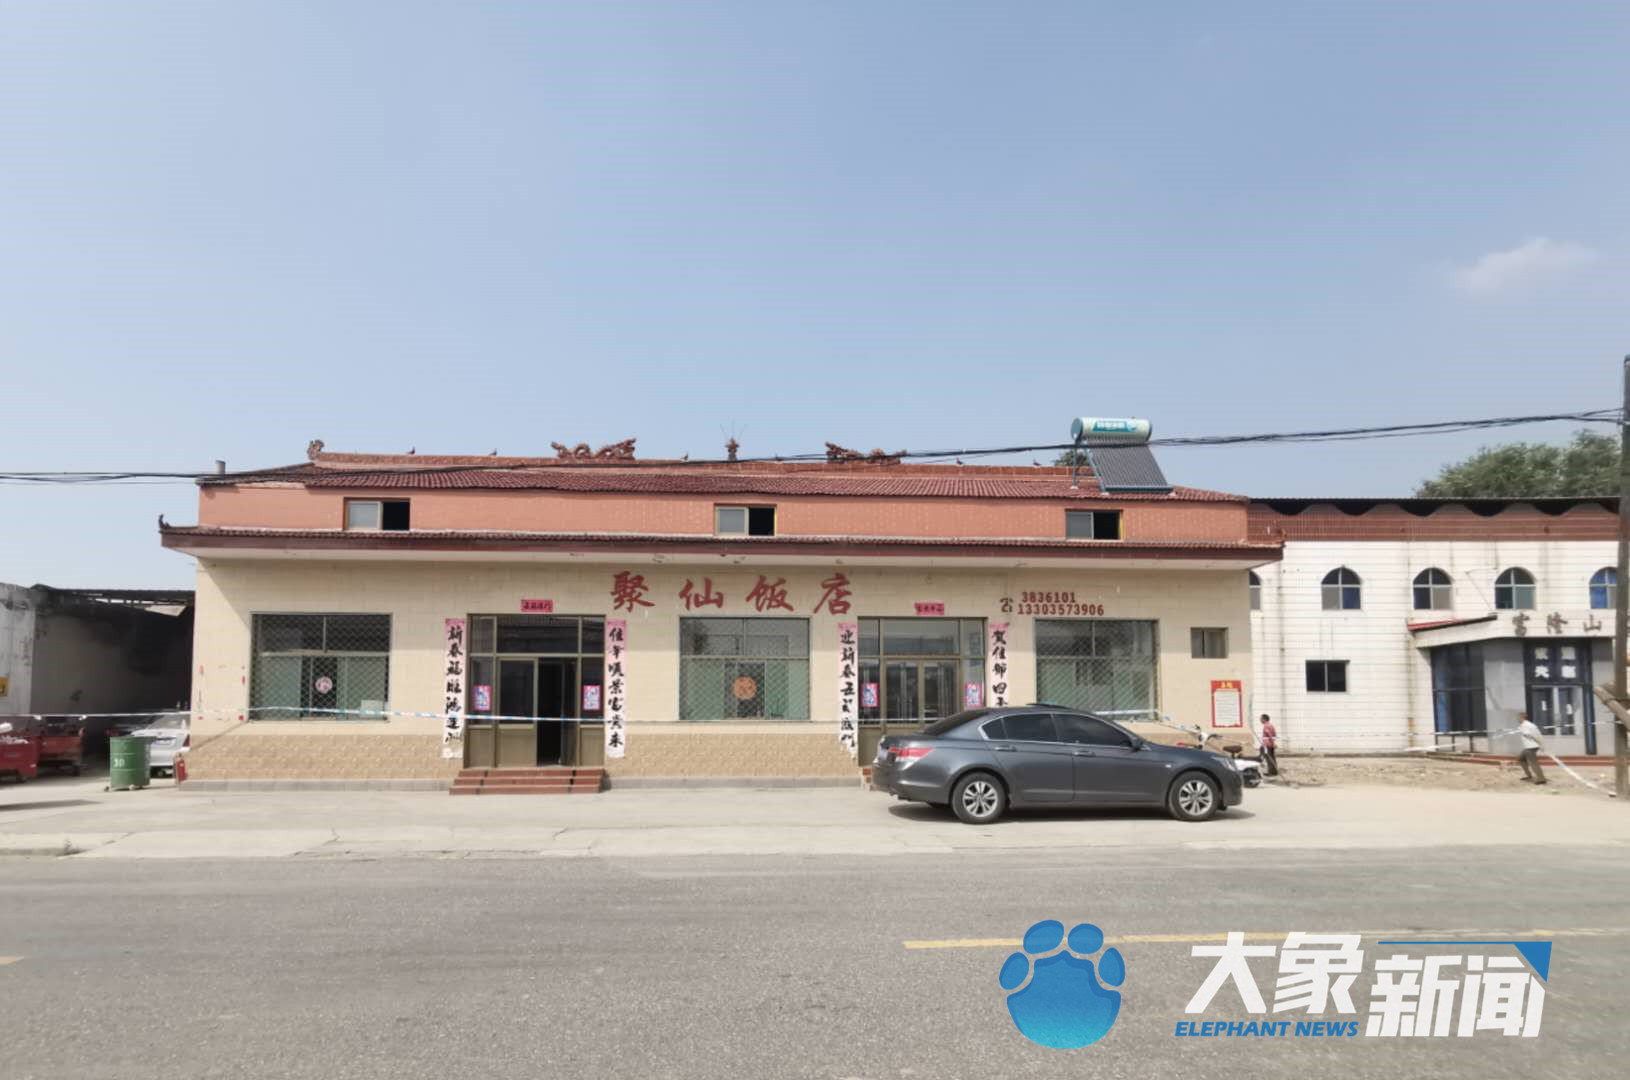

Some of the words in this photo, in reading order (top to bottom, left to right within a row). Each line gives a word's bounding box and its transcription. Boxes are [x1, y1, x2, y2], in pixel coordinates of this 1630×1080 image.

[613, 572, 853, 614] 聚仙饭店
[1022, 591, 1076, 603] 3836101
[1017, 603, 1104, 616] 13303573906
